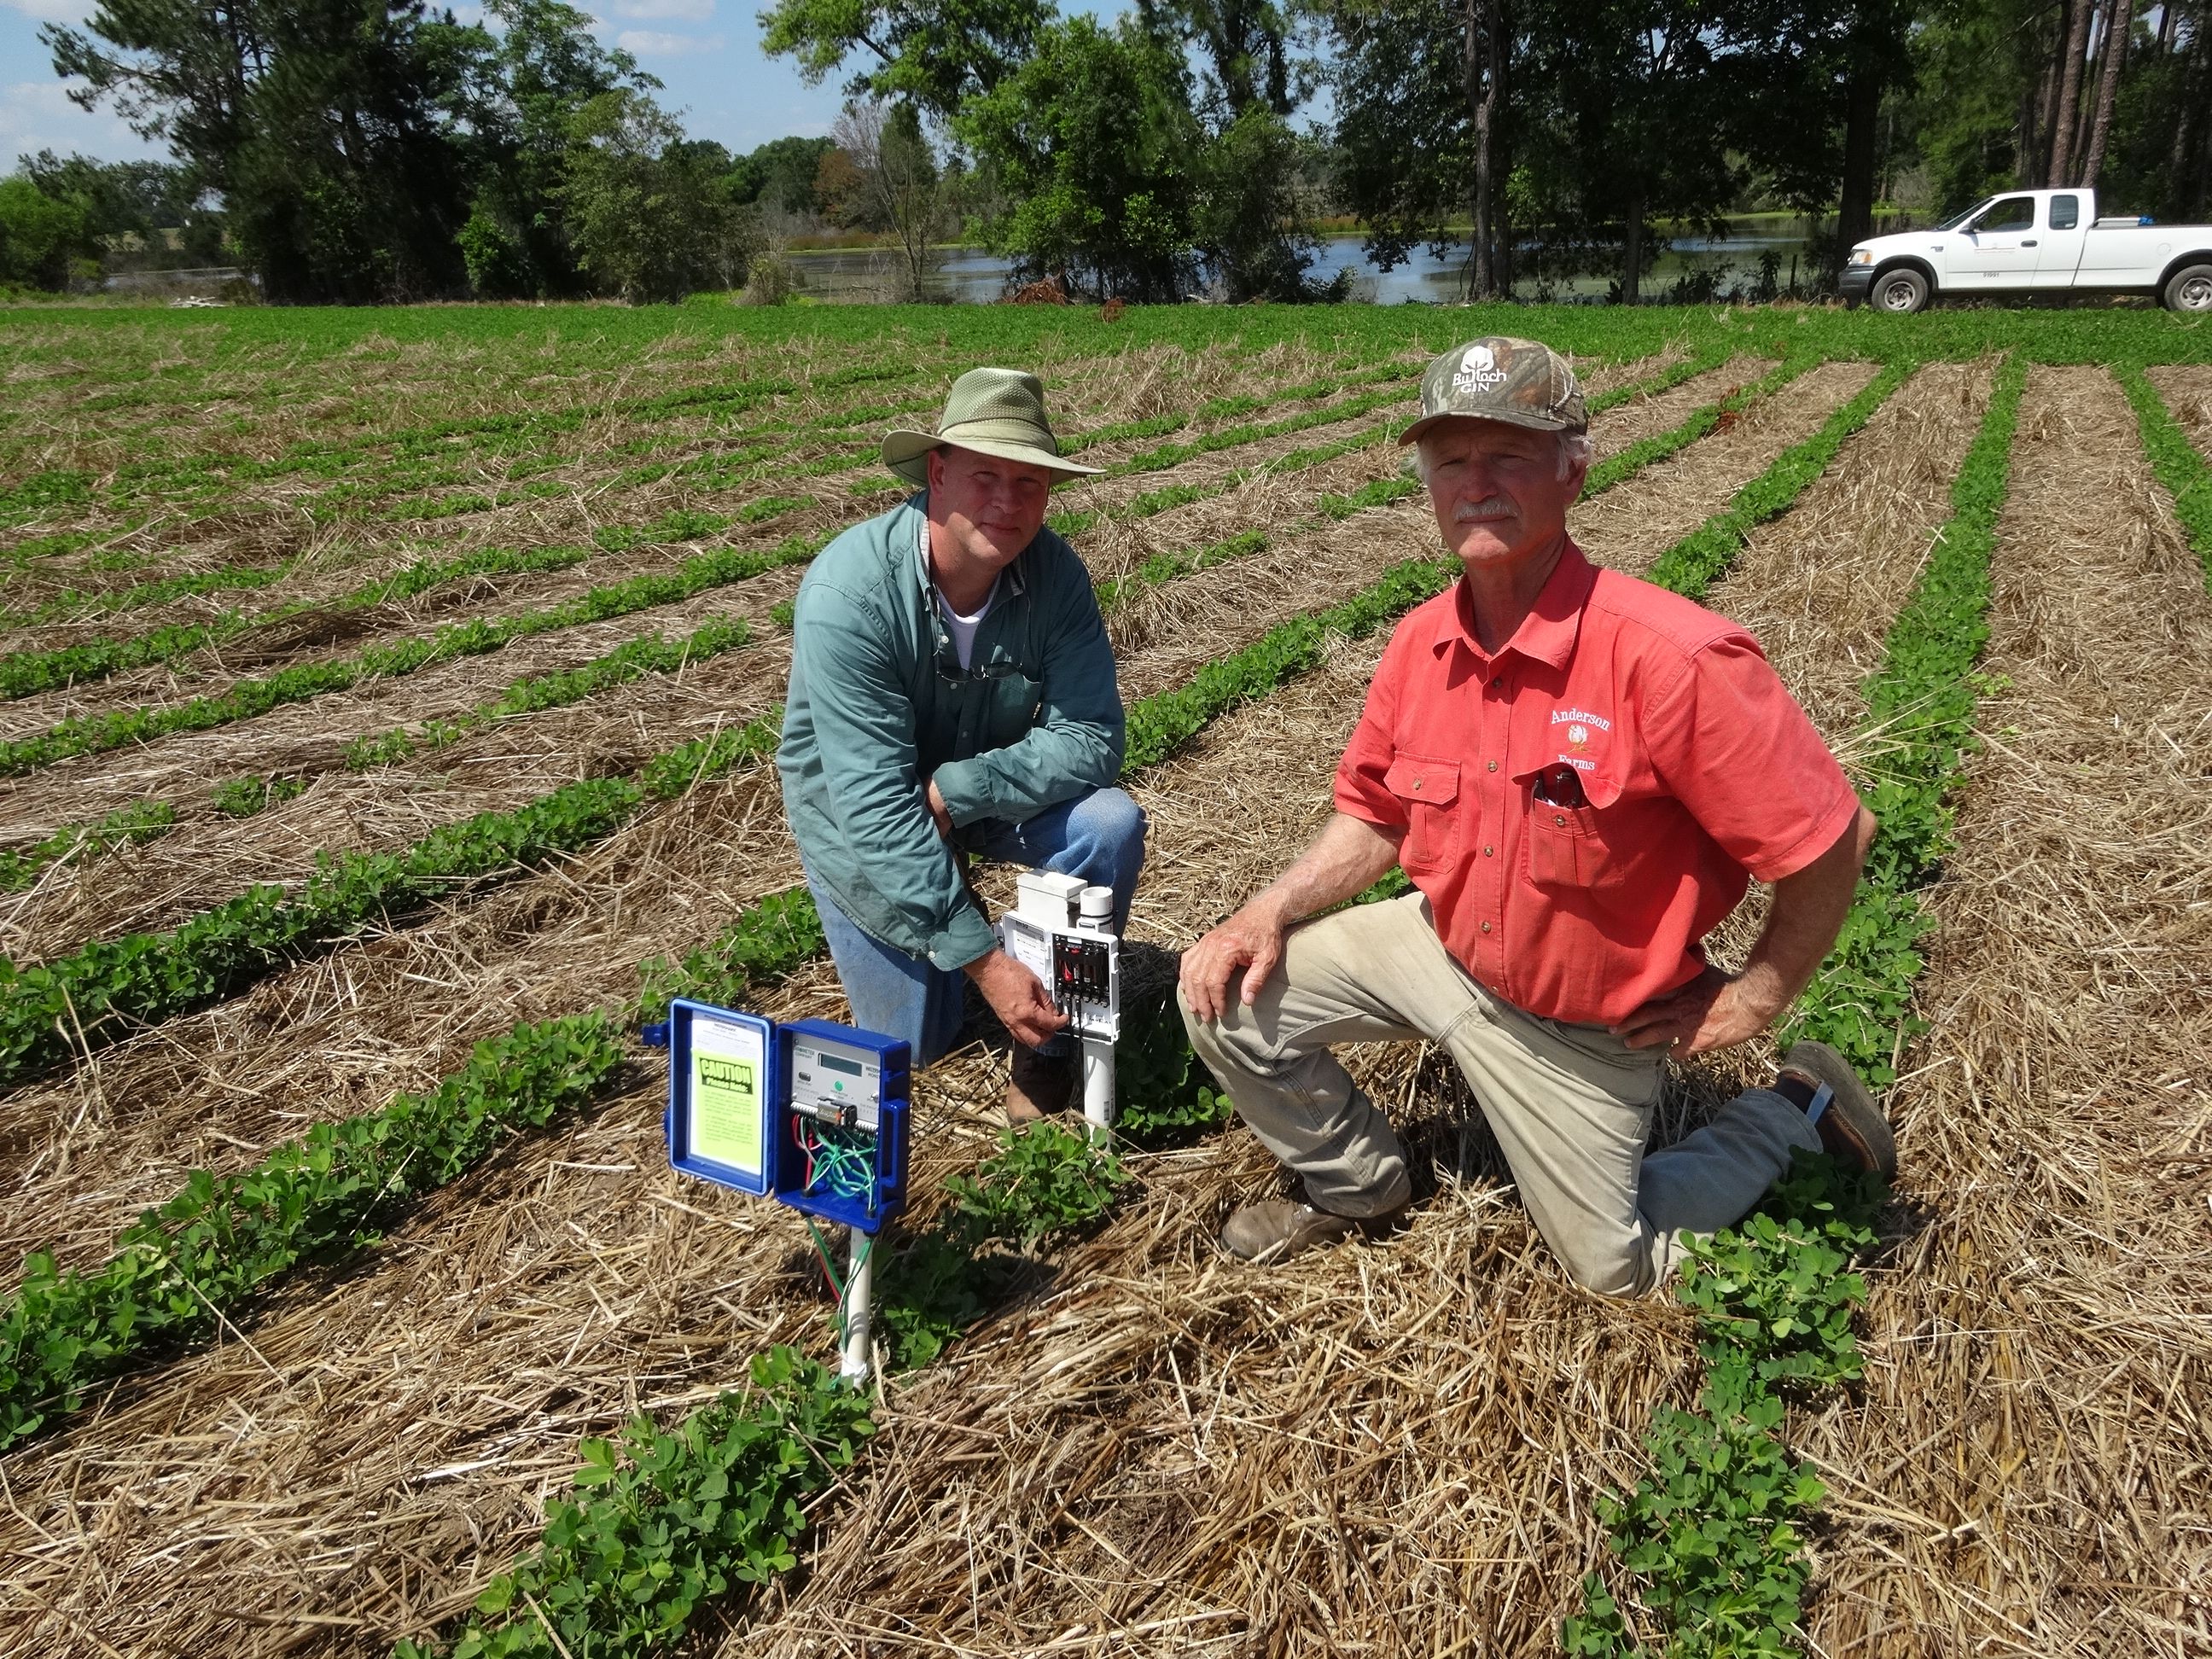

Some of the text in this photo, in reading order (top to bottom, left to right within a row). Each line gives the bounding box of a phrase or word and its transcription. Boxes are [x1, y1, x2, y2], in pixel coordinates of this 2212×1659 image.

[1452, 368, 1507, 387] Bulloch
[1460, 381, 1490, 393] GIN
[1551, 707, 1610, 731] Anderson
[1557, 754, 1596, 771] Farms
[700, 1059, 751, 1084] CAUTION
